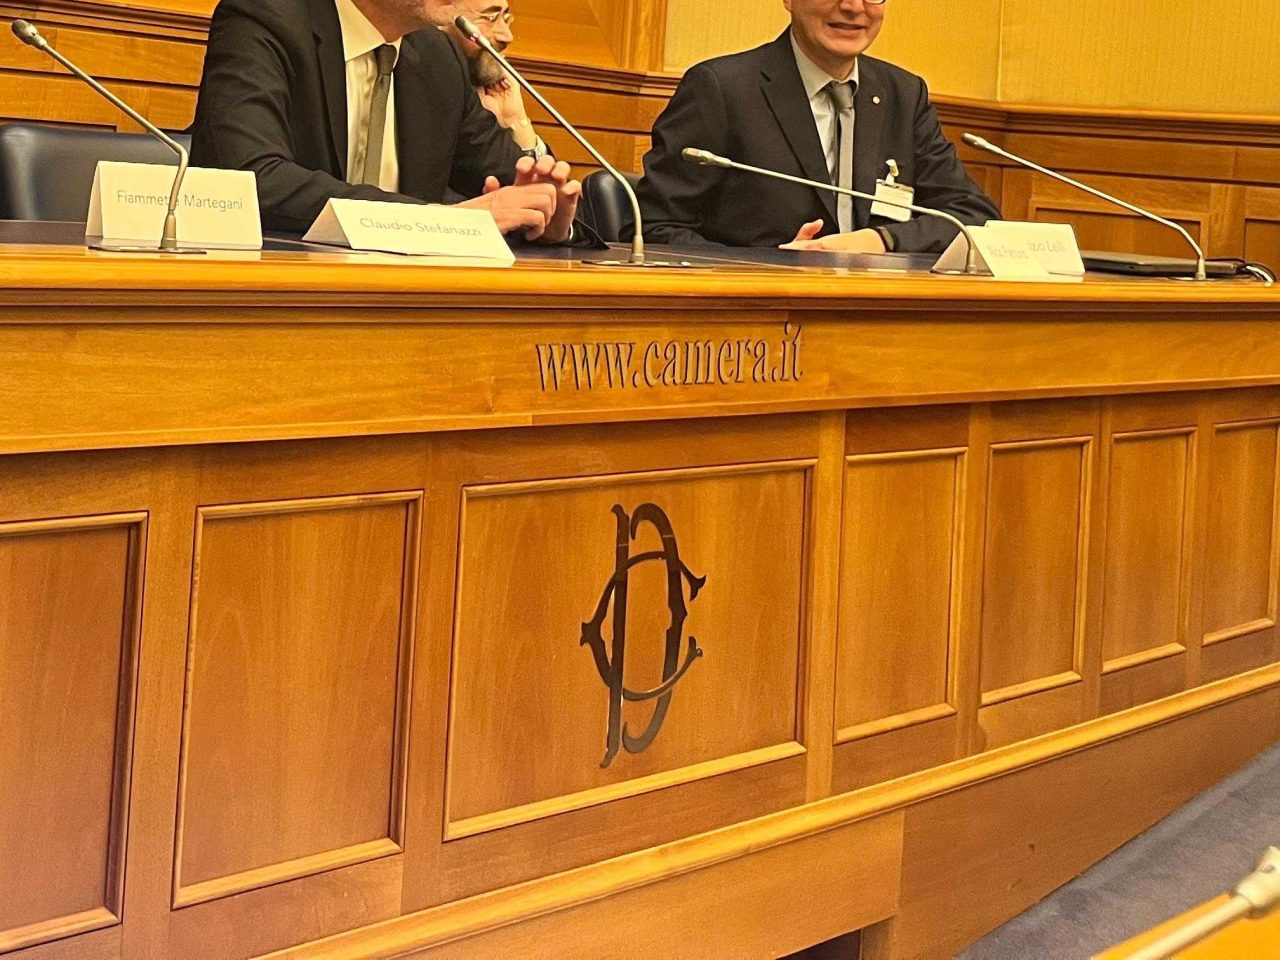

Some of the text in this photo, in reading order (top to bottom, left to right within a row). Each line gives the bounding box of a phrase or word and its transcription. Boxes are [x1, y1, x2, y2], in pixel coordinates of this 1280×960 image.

[184, 194, 244, 213] Martegani
[359, 217, 413, 232] Claudio
[535, 321, 804, 391] www.camera.it
